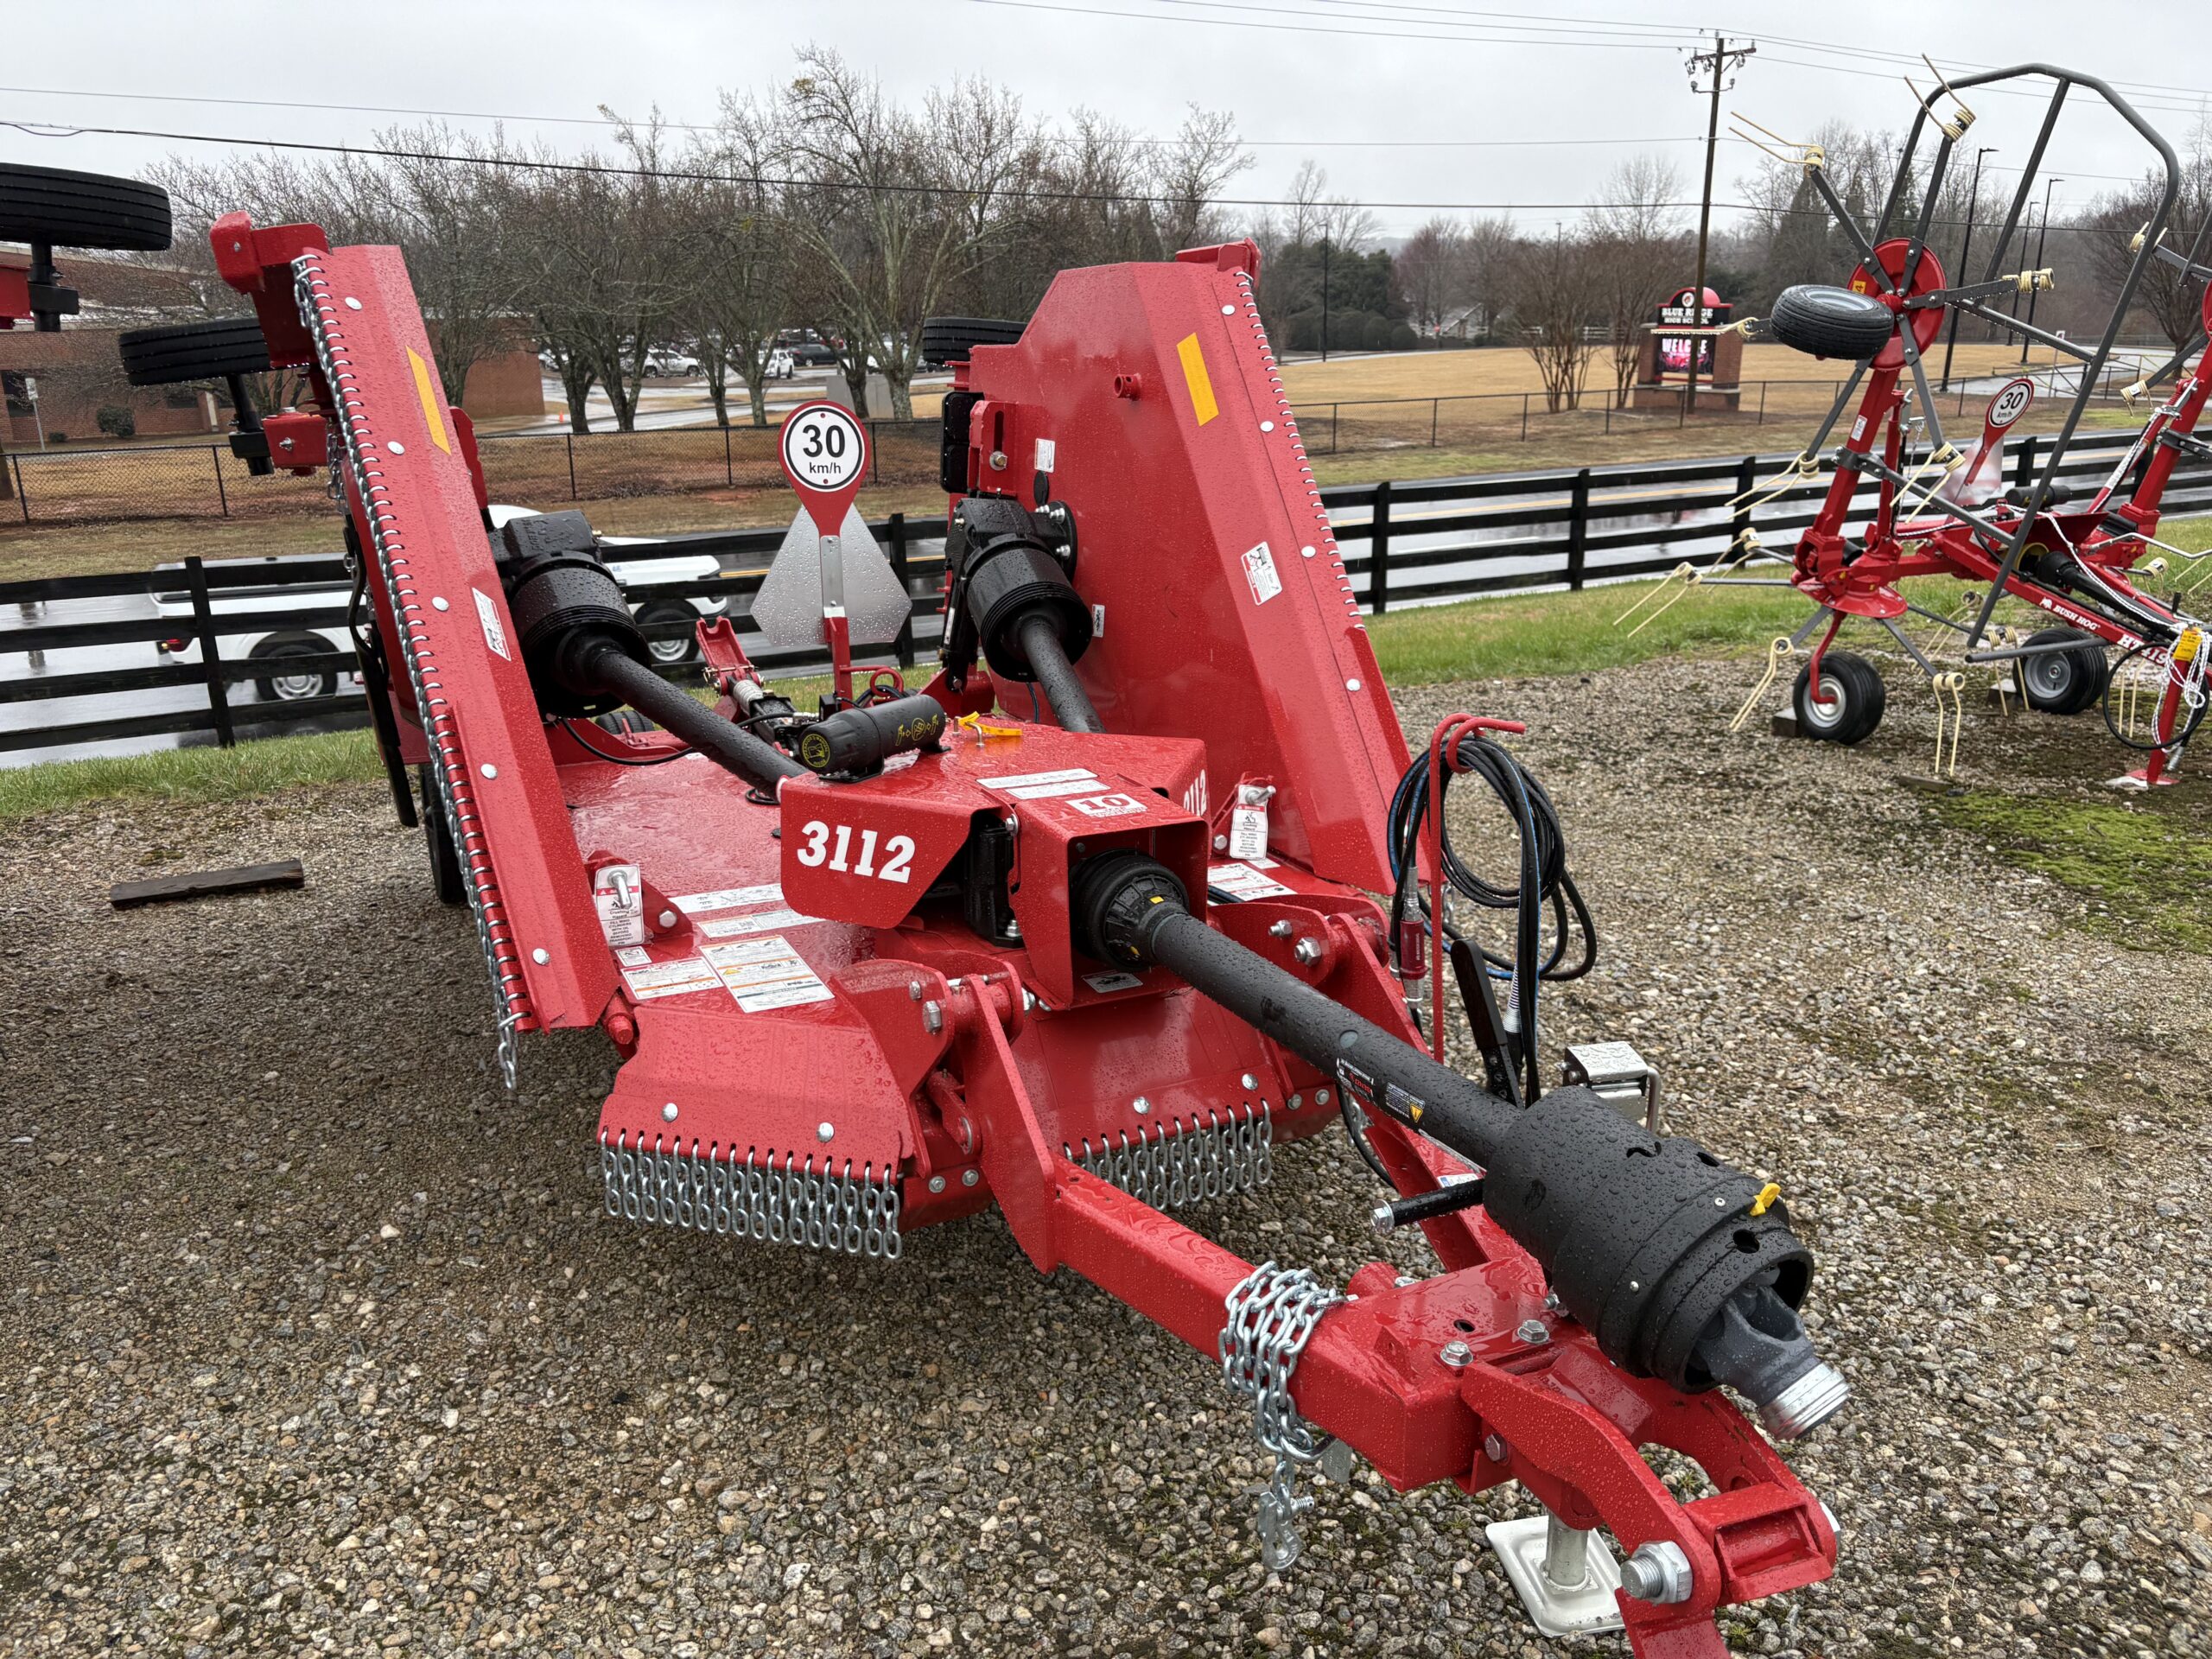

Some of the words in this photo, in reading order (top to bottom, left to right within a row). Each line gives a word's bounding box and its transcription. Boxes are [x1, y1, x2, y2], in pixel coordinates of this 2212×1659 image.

[1662, 308, 1684, 316] BLUE
[1685, 308, 1713, 317] RIGE
[1662, 338, 1707, 354] WELCE
[2000, 391, 2024, 410] 30
[803, 424, 846, 459] 30
[809, 461, 842, 474] km/h
[2053, 605, 2077, 621] BUSH
[1079, 797, 1130, 810] 10
[797, 821, 916, 884] 3112
